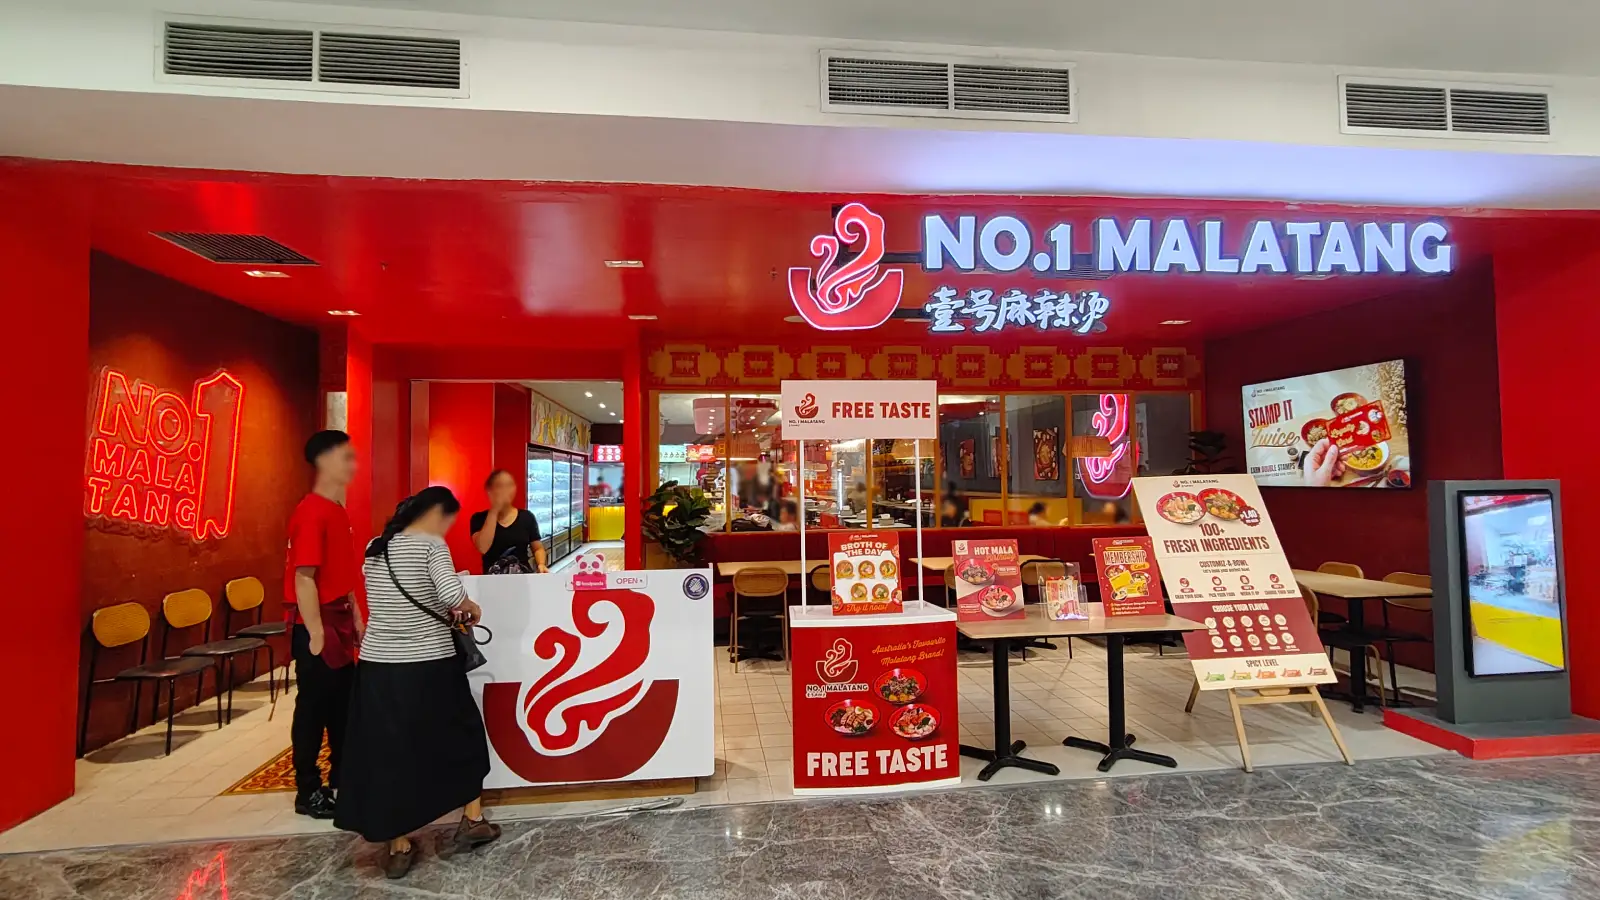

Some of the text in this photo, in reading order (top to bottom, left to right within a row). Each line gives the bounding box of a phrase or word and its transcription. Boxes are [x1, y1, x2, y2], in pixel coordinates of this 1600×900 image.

[924, 214, 1453, 274] NO.1 MALATANG
[926, 287, 1110, 333] 壹号麻辣烫
[832, 402, 931, 418] FREE TASTE
[1248, 399, 1293, 428] STAMP IT
[1252, 424, 1300, 447] Twice
[94, 438, 196, 495] MALA
[1277, 462, 1296, 472] STAMPS
[88, 477, 197, 529] TANG
[1199, 523, 1225, 536] 100+
[841, 541, 888, 551] BROTH OF
[845, 548, 883, 557] THE DAY
[974, 545, 1014, 556] HOT MALA
[1163, 536, 1270, 554] FRESH INGREDIENTS
[1103, 551, 1147, 565] MEMBERSHIP
[616, 577, 638, 585] OPEN
[1234, 604, 1249, 612] YOUR
[872, 637, 946, 655] Australia's Favourite
[880, 649, 945, 667] Malatang Brand!
[1246, 659, 1279, 668] SPICY LEVEL
[826, 683, 869, 692] MALATANG
[806, 744, 948, 777] FREE TASTE
